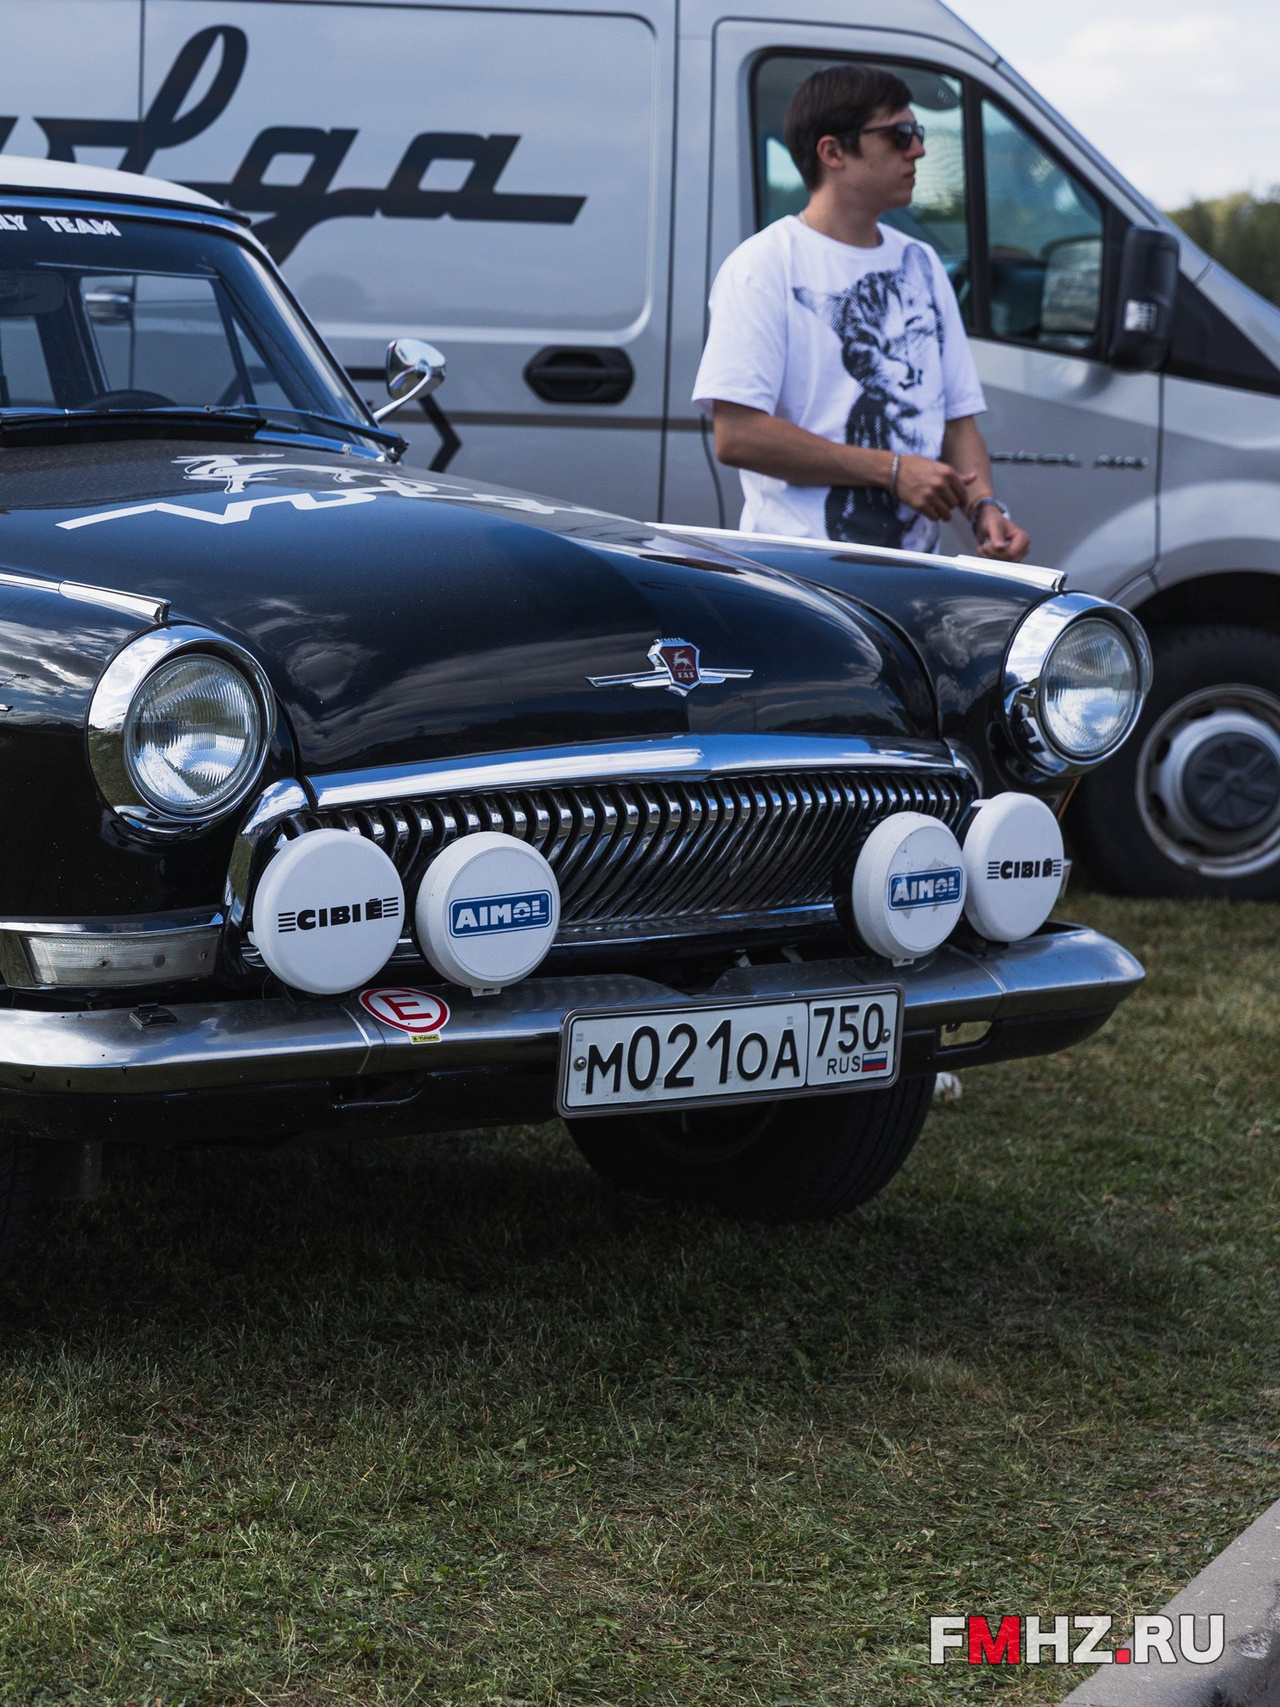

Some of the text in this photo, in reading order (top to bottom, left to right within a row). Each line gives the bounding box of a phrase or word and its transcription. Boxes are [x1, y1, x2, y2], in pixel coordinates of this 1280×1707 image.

[39, 215, 122, 237] TEAM
[892, 875, 959, 903] AIMOL
[296, 897, 383, 931] CIBIÉ
[454, 899, 548, 930] AIMOL
[377, 993, 434, 1021] E
[813, 1002, 885, 1058] 750
[826, 1055, 861, 1076] RUS
